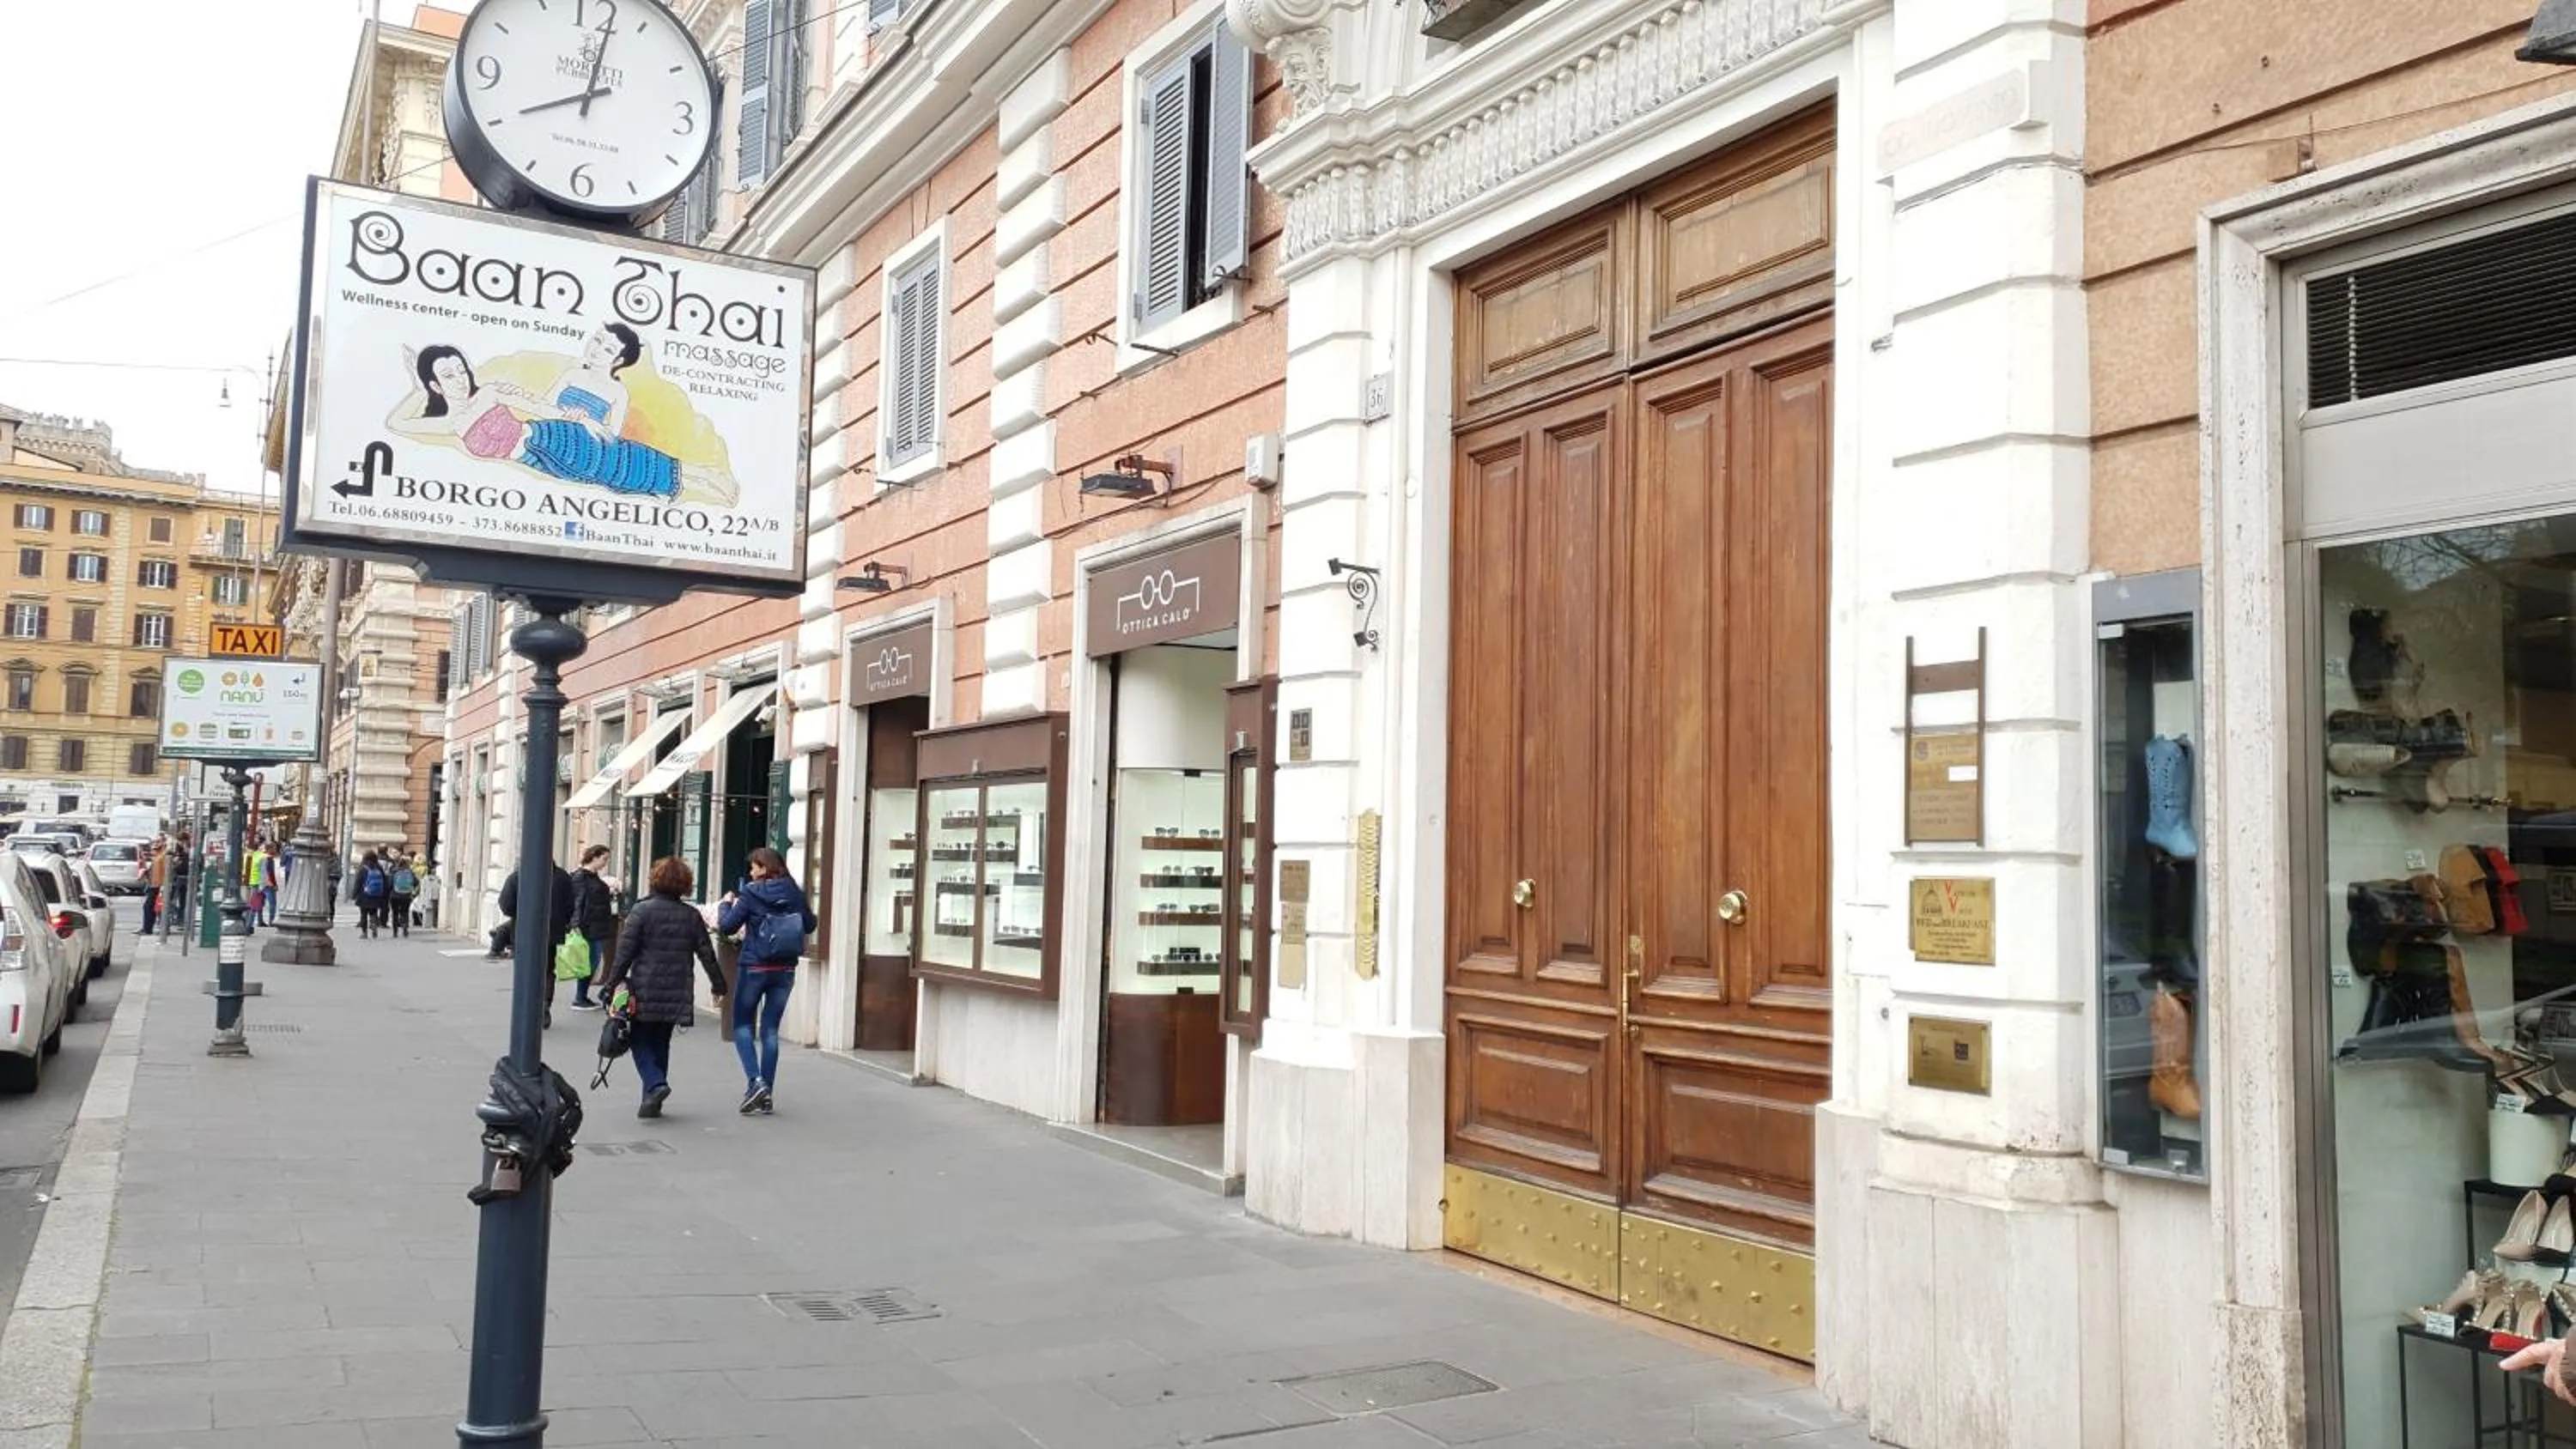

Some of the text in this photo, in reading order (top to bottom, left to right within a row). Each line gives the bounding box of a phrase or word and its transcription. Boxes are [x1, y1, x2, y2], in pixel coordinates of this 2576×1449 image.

[477, 56, 501, 90] 9
[556, 55, 623, 79] MORTTI
[672, 101, 694, 136] 3
[570, 163, 595, 197] 6
[345, 211, 786, 349] Baan Thai
[343, 289, 408, 311] Wellness
[412, 302, 459, 318] center
[471, 312, 508, 328] open
[511, 318, 530, 330] on
[532, 320, 586, 341] Sunday
[663, 339, 787, 379] massage
[662, 365, 786, 392] DE-CONTRACTING
[690, 383, 758, 403] RELAXING
[396, 476, 527, 511] BORGO
[536, 494, 715, 536] ANGELICO,
[586, 530, 654, 549] BaanThai
[664, 541, 777, 561] www.baanthai.it
[218, 627, 277, 654] TAXI
[1122, 615, 1159, 634] OTTICA
